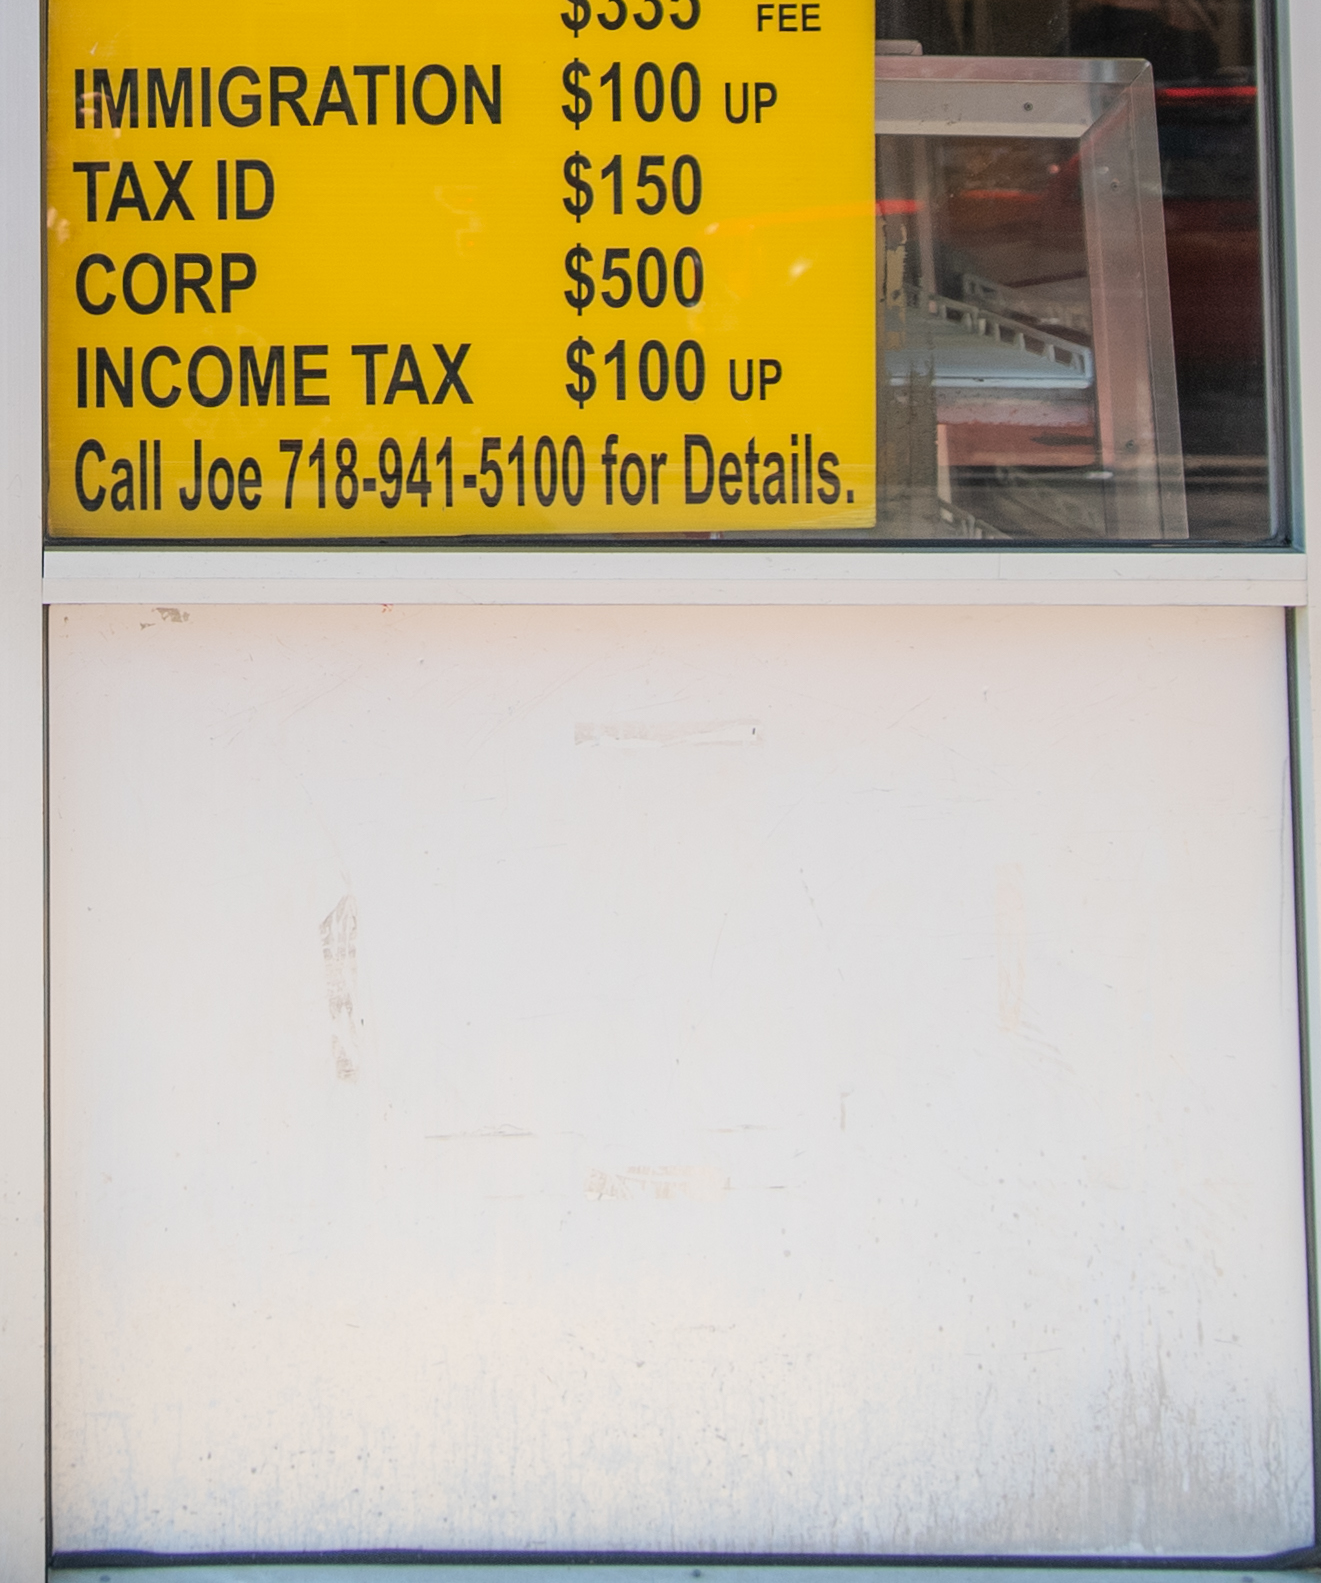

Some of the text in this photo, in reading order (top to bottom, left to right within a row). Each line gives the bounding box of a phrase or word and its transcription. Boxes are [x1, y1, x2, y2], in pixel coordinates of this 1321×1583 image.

[757, 3, 821, 32] FEE
[74, 64, 502, 130] IMMIGRATION
[561, 57, 778, 131] $100 UP
[72, 159, 275, 222] TAX ID
[562, 150, 702, 224] $150
[75, 252, 257, 316] CORP
[564, 242, 704, 316] $500
[77, 343, 474, 409] INCOME TAX
[565, 335, 782, 410] $100 UP
[74, 433, 854, 513] Call Joe 718-941-5100 for Details.
